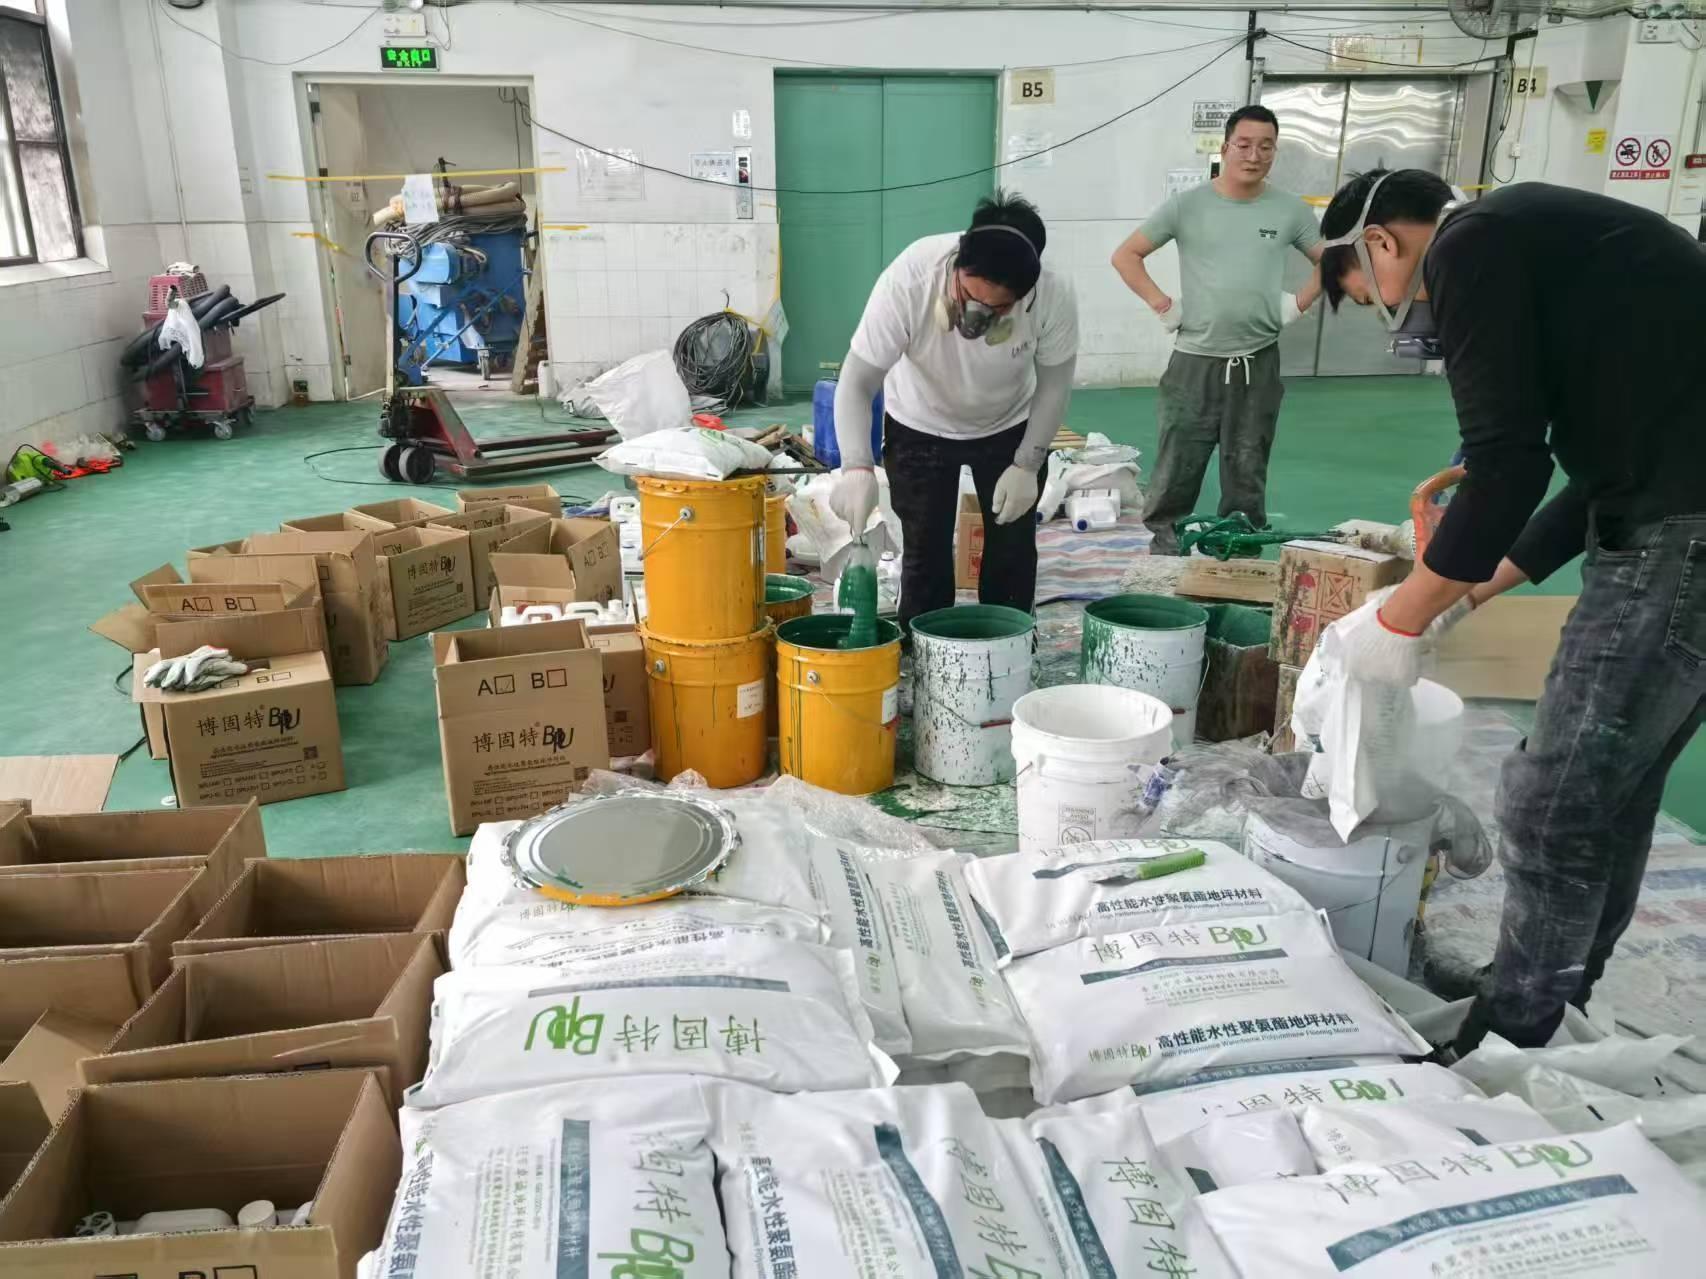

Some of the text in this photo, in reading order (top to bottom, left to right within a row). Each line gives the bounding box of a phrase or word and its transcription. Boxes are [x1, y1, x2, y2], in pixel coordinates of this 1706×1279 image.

[1022, 81, 1044, 98] B5
[1517, 78, 1537, 93] B4
[181, 597, 238, 611] A B
[477, 672, 546, 696] A B
[472, 728, 539, 753] 博固特
[1097, 888, 1262, 913] 高性能水性聚氨酯地坪材料
[1090, 928, 1201, 963] 博固特
[612, 1014, 766, 1056] 博固特
[1158, 1013, 1354, 1049] 高性能水性聚氨酯地坪材料
[1201, 1083, 1324, 1114] 固特
[1327, 1151, 1494, 1205] 博固特
